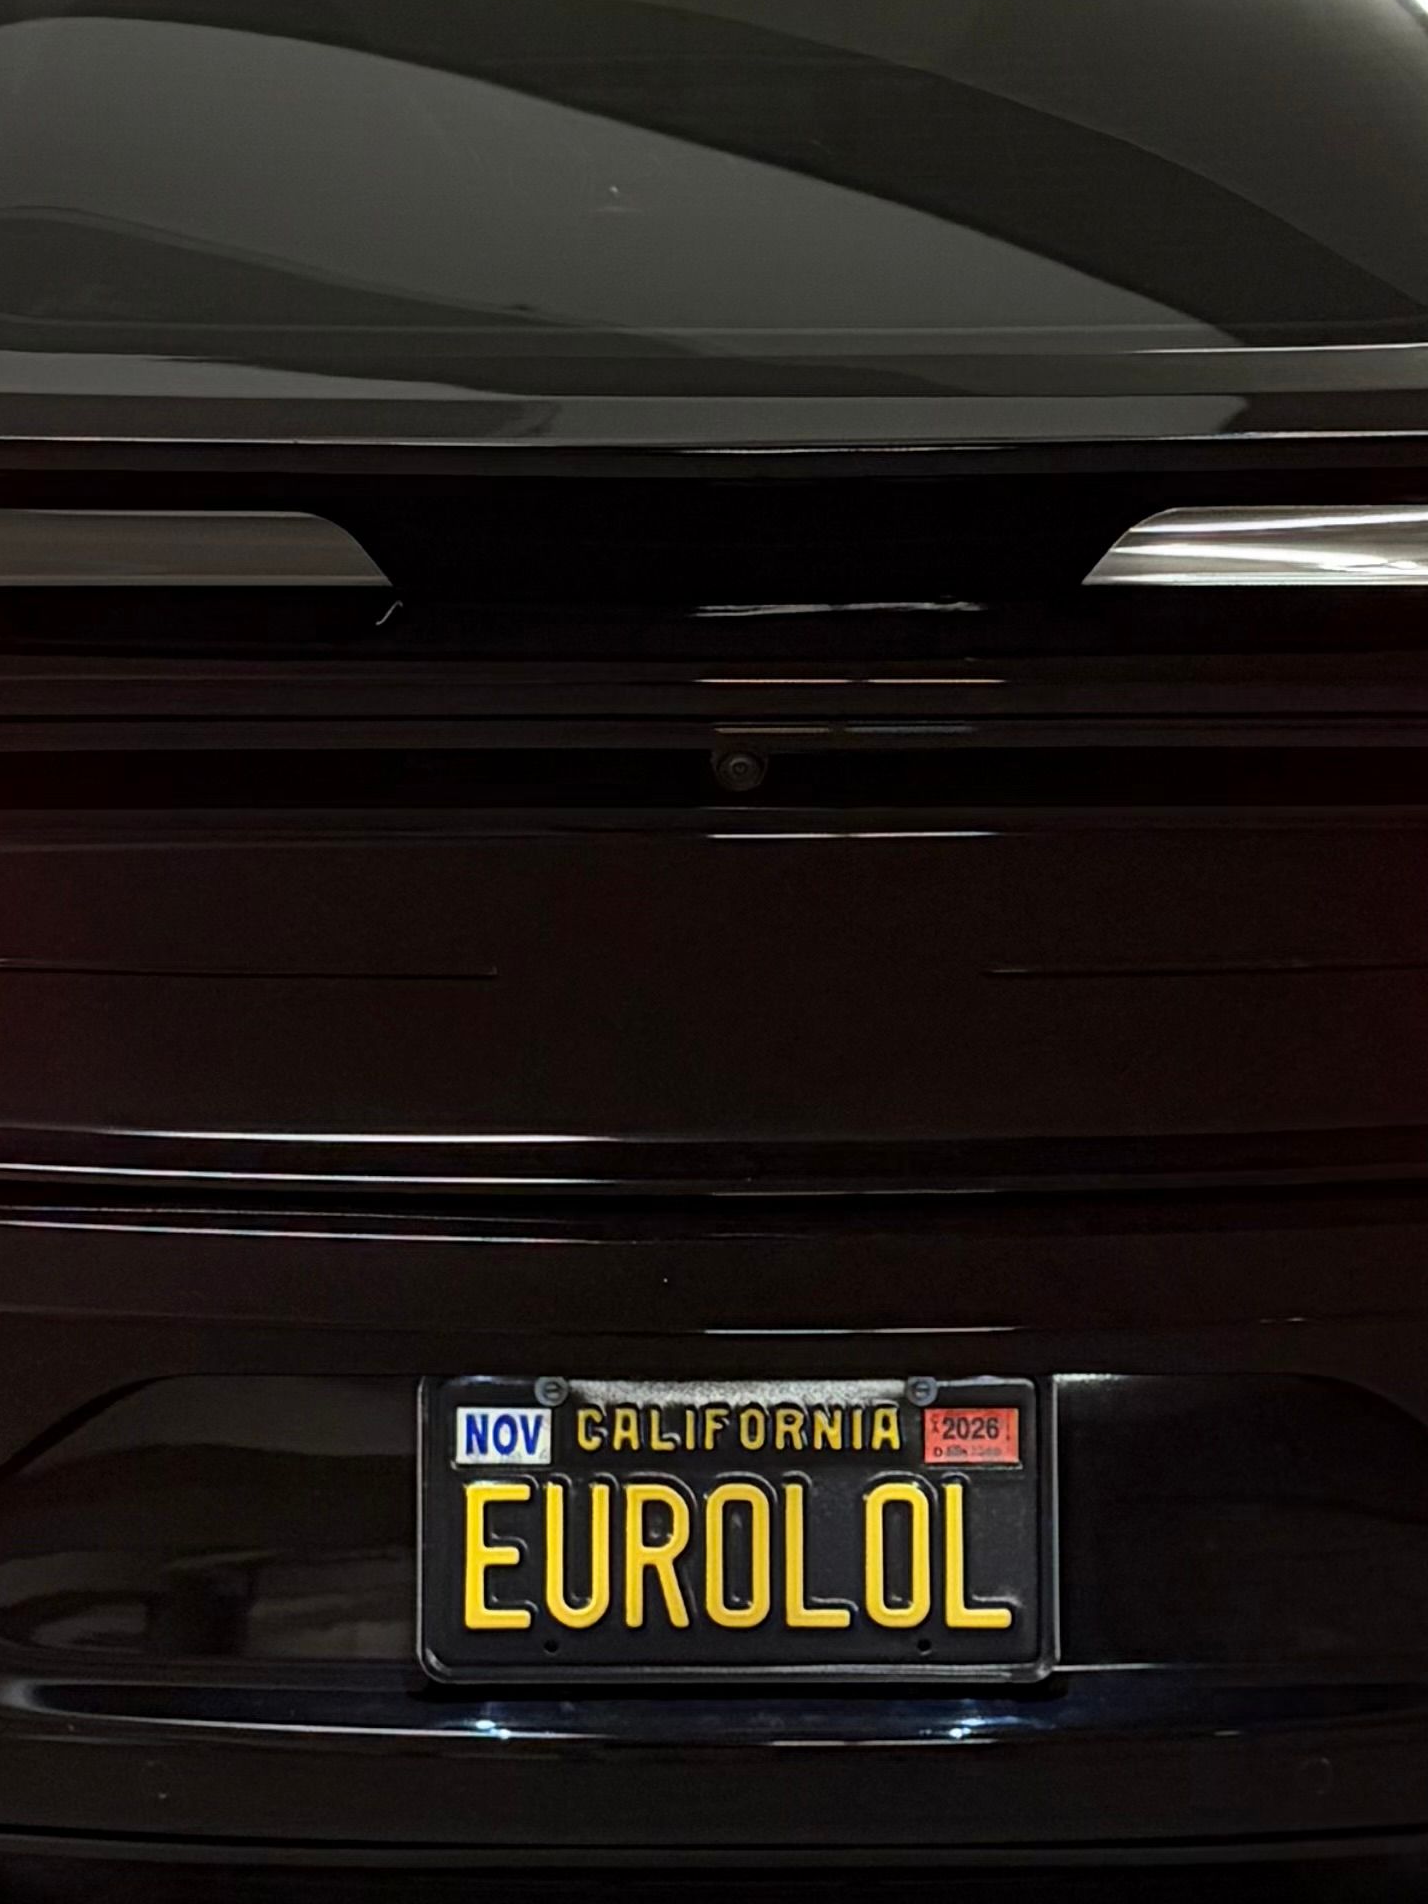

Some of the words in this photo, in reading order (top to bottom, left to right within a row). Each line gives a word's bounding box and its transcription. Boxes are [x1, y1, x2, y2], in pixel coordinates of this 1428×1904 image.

[465, 1413, 544, 1456] NOV
[576, 1407, 902, 1452] CALIFORNIA
[941, 1416, 1001, 1441] 2026
[464, 1482, 1013, 1630] EUROLOL
